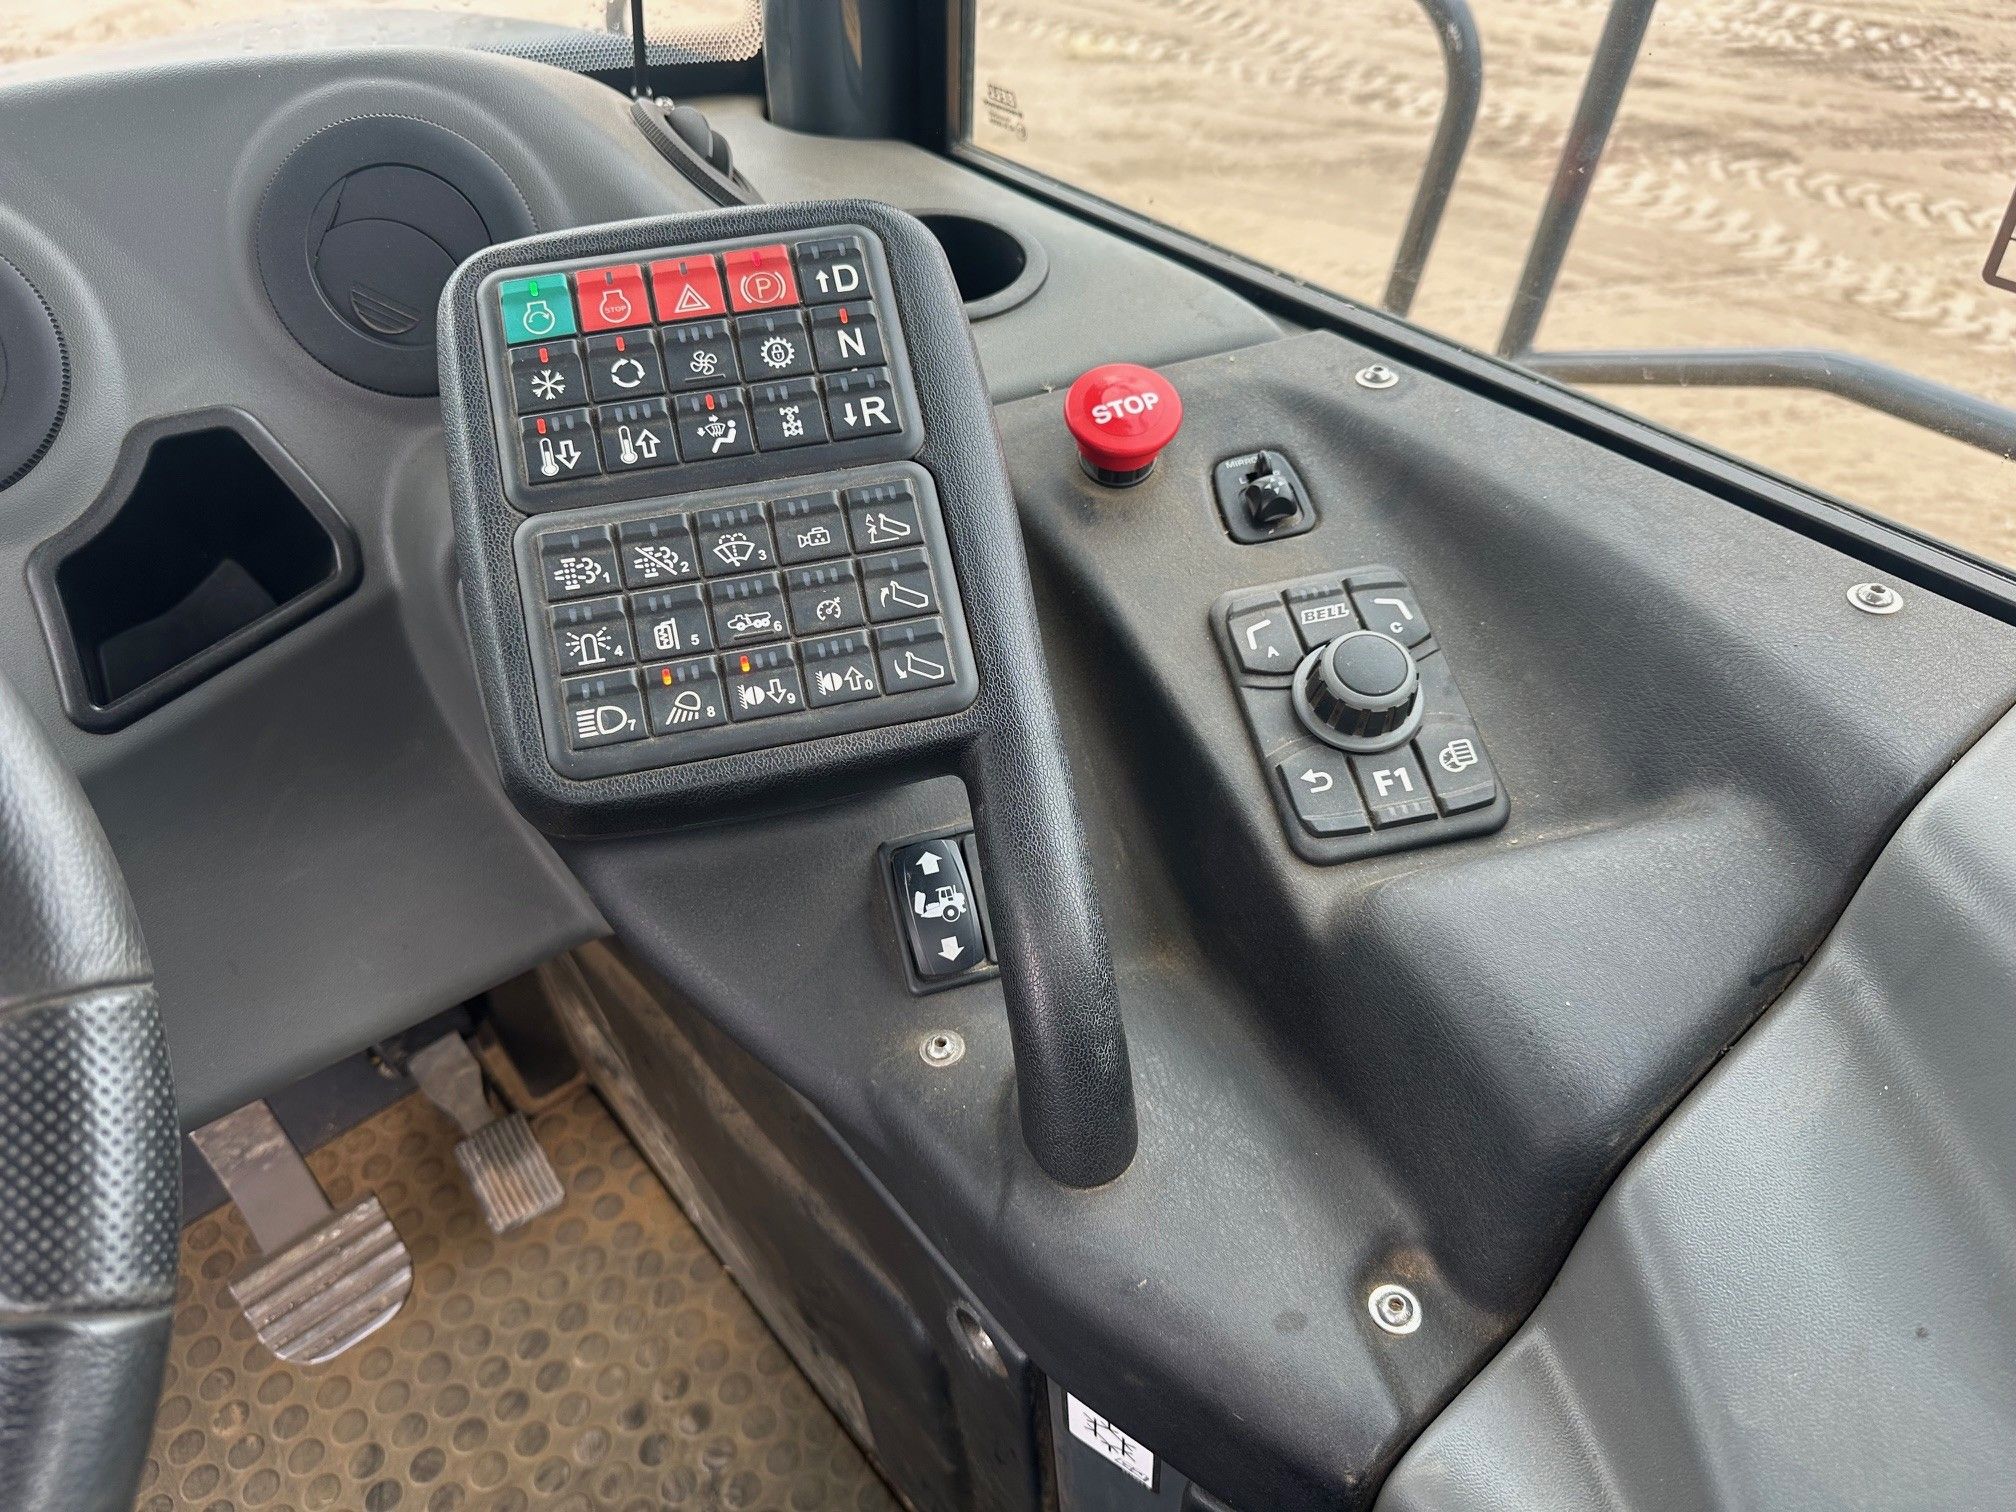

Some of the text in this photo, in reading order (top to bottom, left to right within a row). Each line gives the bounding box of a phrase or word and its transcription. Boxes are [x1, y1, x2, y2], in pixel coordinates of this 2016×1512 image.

[831, 264, 859, 293] D
[754, 277, 774, 301] P
[604, 304, 628, 315] STOP
[837, 327, 866, 358] N
[860, 396, 893, 427] R
[1091, 391, 1160, 425] STOP
[757, 549, 768, 561] 3
[679, 561, 690, 573] 2
[602, 571, 611, 584] 1
[1300, 604, 1350, 625] BELL
[773, 620, 783, 632] 6
[1389, 621, 1404, 634] C
[690, 633, 700, 646] 5
[613, 644, 624, 657] 4
[1267, 645, 1280, 659] A
[785, 691, 796, 705] 9
[706, 705, 716, 718] 8
[627, 718, 637, 731] 7
[1372, 766, 1414, 797] F1
